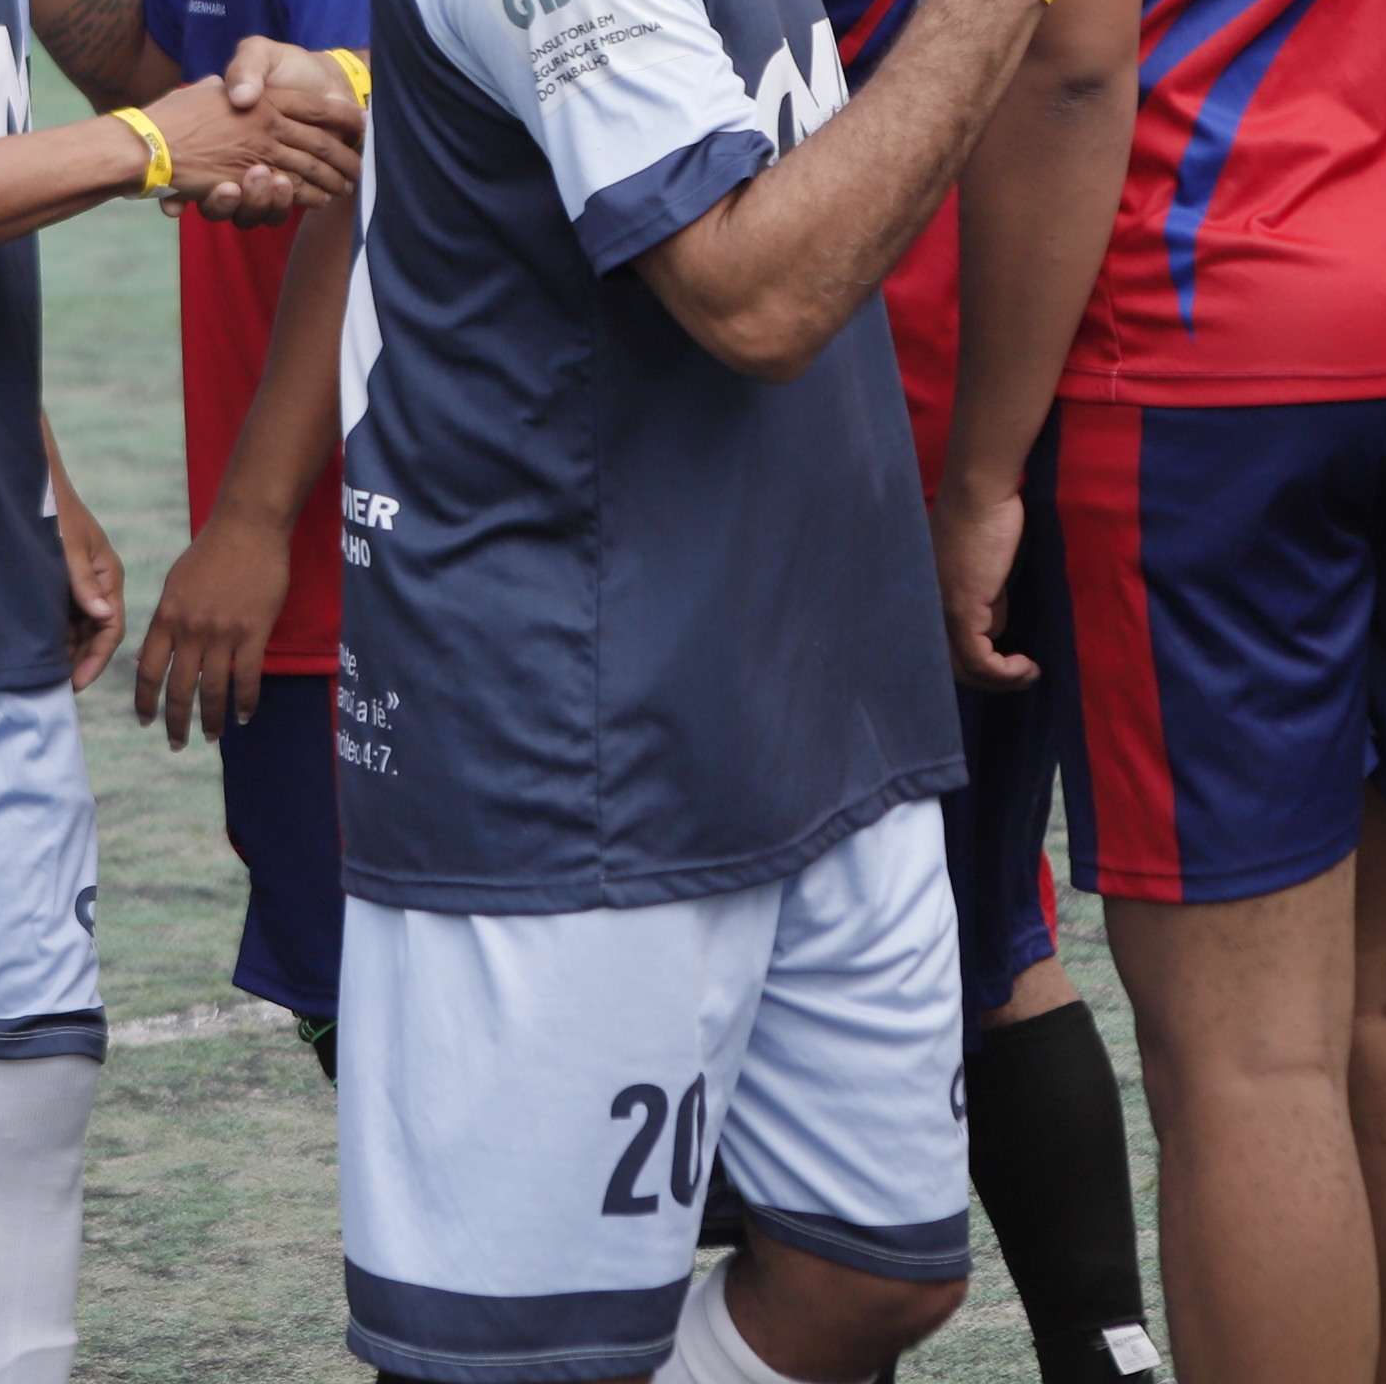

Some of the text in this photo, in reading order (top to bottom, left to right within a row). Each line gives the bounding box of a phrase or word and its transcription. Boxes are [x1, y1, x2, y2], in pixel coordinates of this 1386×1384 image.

[530, 13, 616, 64] ONSULTORIA EM
[534, 41, 593, 83] EGURANÇA
[600, 21, 664, 47] MEDICINA
[537, 53, 610, 103] DO TRABALHO
[601, 1071, 708, 1216] 20
